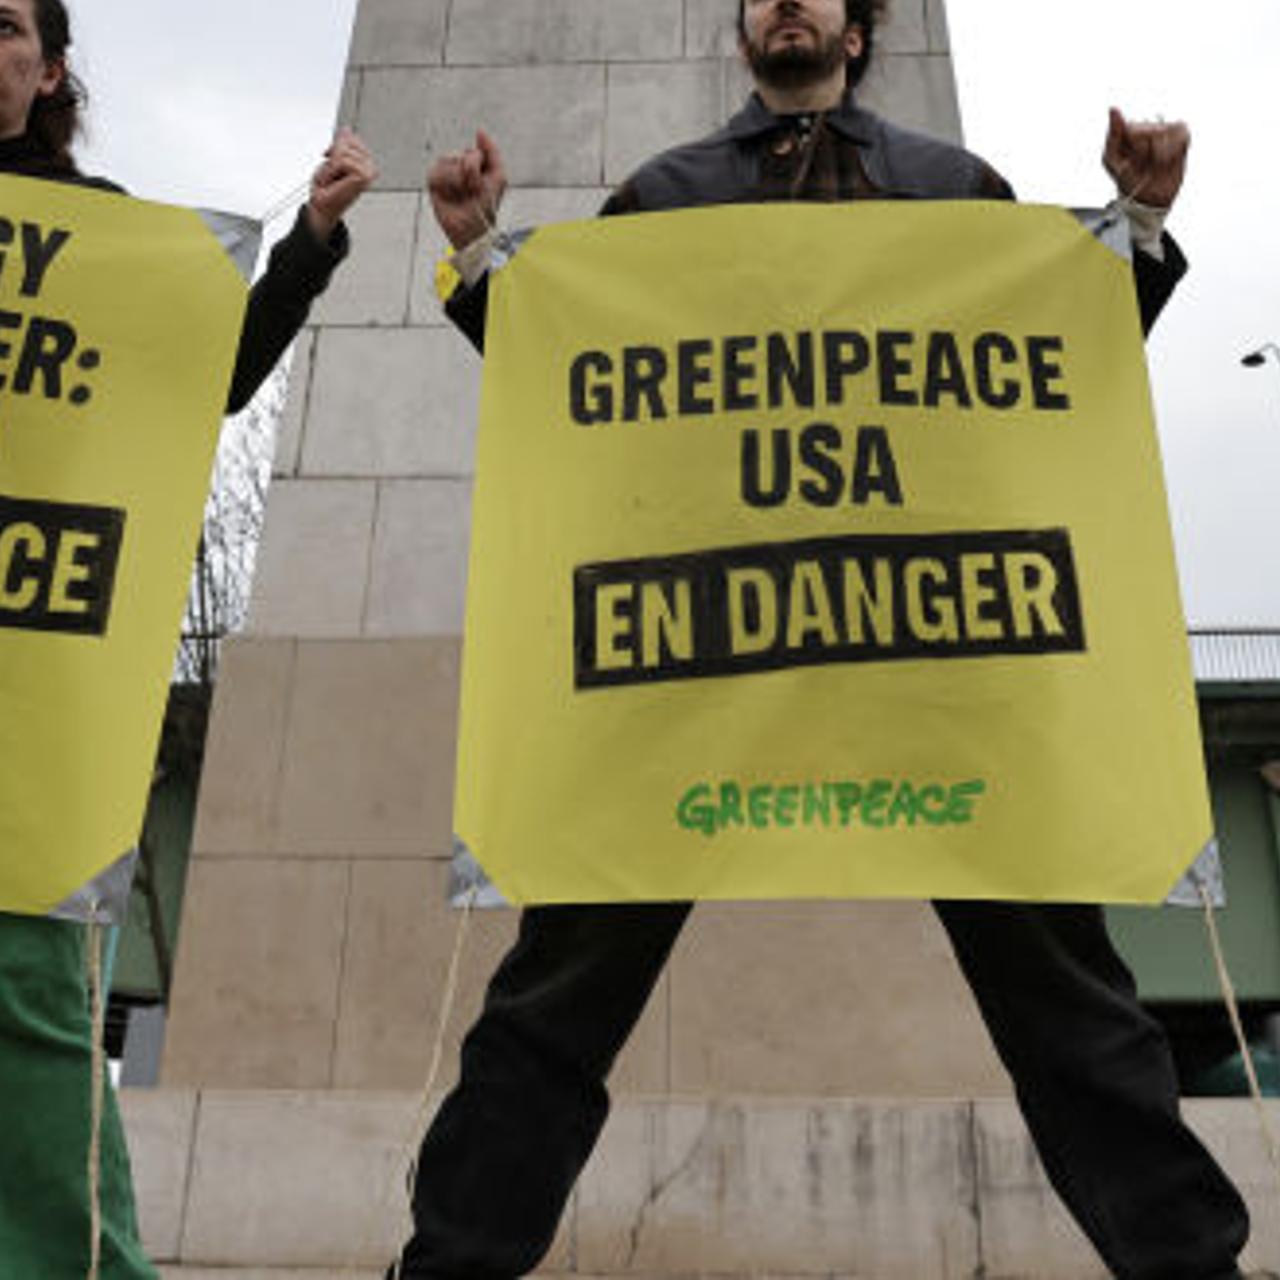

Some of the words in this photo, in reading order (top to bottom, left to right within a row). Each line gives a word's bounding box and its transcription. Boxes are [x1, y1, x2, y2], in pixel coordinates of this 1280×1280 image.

[568, 329, 1071, 426] GREENPEACE
[740, 424, 904, 508] USA
[593, 579, 694, 670] EN
[727, 551, 1064, 656] DANGER
[676, 777, 986, 834] GREENPEACE
